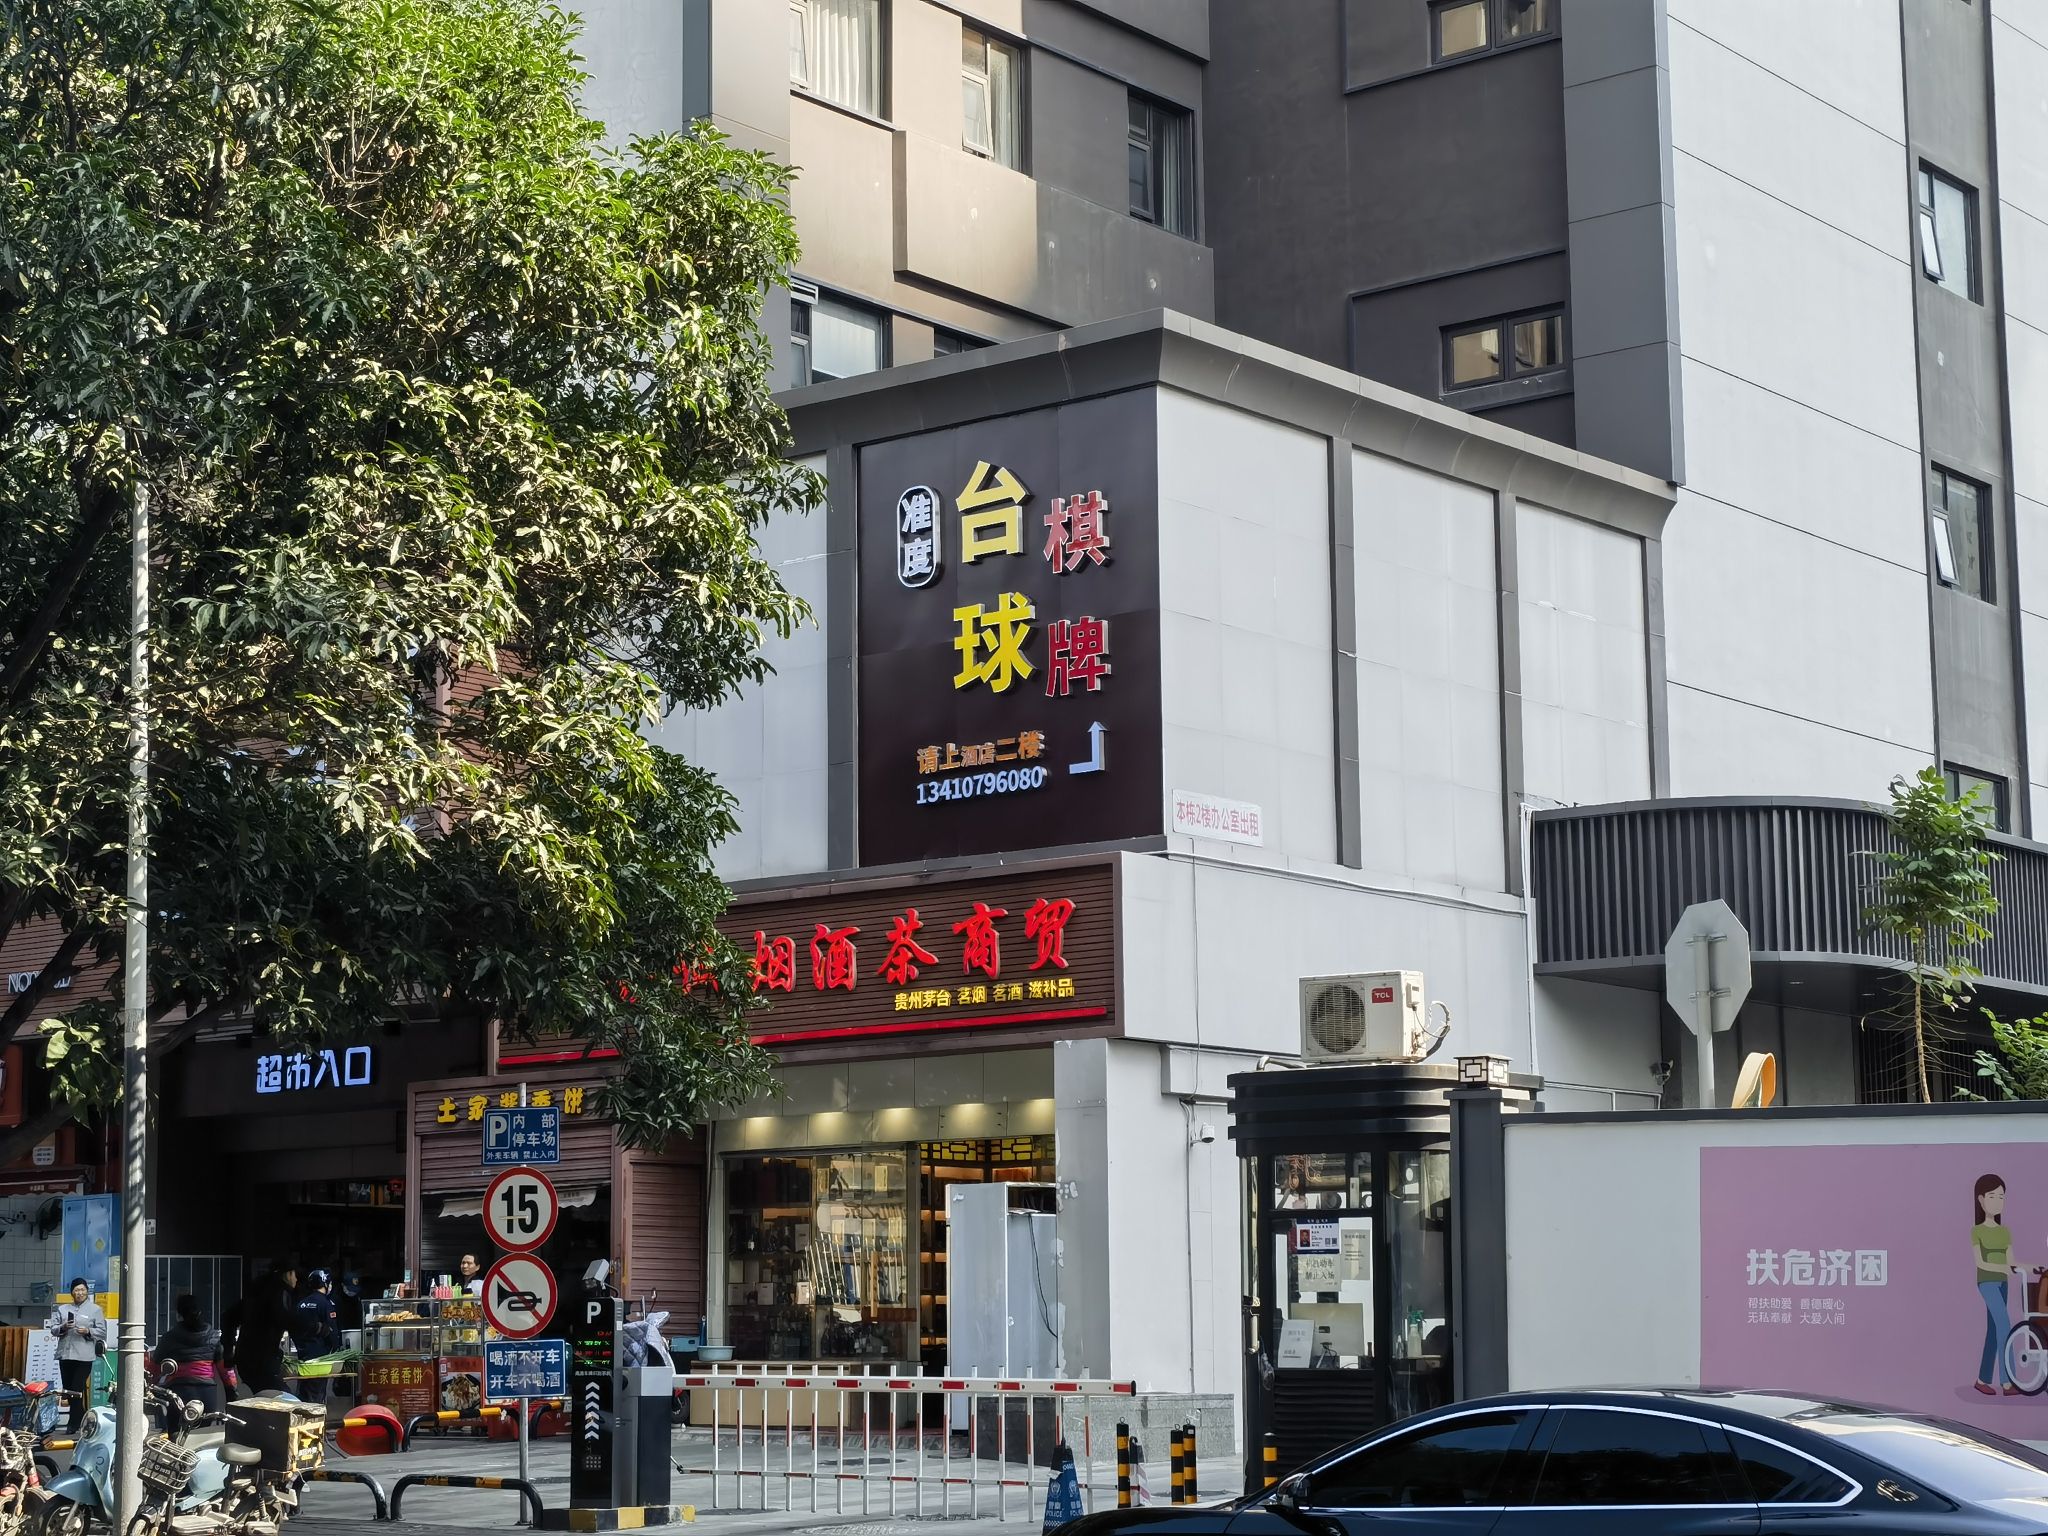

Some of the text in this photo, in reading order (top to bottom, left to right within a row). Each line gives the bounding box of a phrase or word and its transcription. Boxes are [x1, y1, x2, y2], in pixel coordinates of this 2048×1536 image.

[901, 494, 932, 577] 准度
[953, 460, 1036, 693] 台球
[1043, 490, 1111, 698] 棋牌
[916, 731, 1044, 774] 请上酒店二楼
[916, 766, 1046, 804] 13410796080
[1176, 799, 1260, 837] 本栋2楼办公室出租
[606, 897, 1077, 1003] 烟酒茶商贸
[894, 990, 951, 1011] 贵州茅台
[1028, 978, 1075, 998] 滋补品
[256, 1046, 372, 1093] 超市入口
[489, 1116, 507, 1146] P
[512, 1131, 555, 1147] 停车场
[523, 1150, 555, 1159] 禁止入内
[501, 1185, 539, 1234] 15
[1746, 1248, 1888, 1286] 扶危济困
[587, 1302, 602, 1324] P
[1800, 1312, 1845, 1324] 大爱人间
[489, 1349, 561, 1366] 喝酒不开车
[490, 1371, 561, 1388] 开车不喝酒
